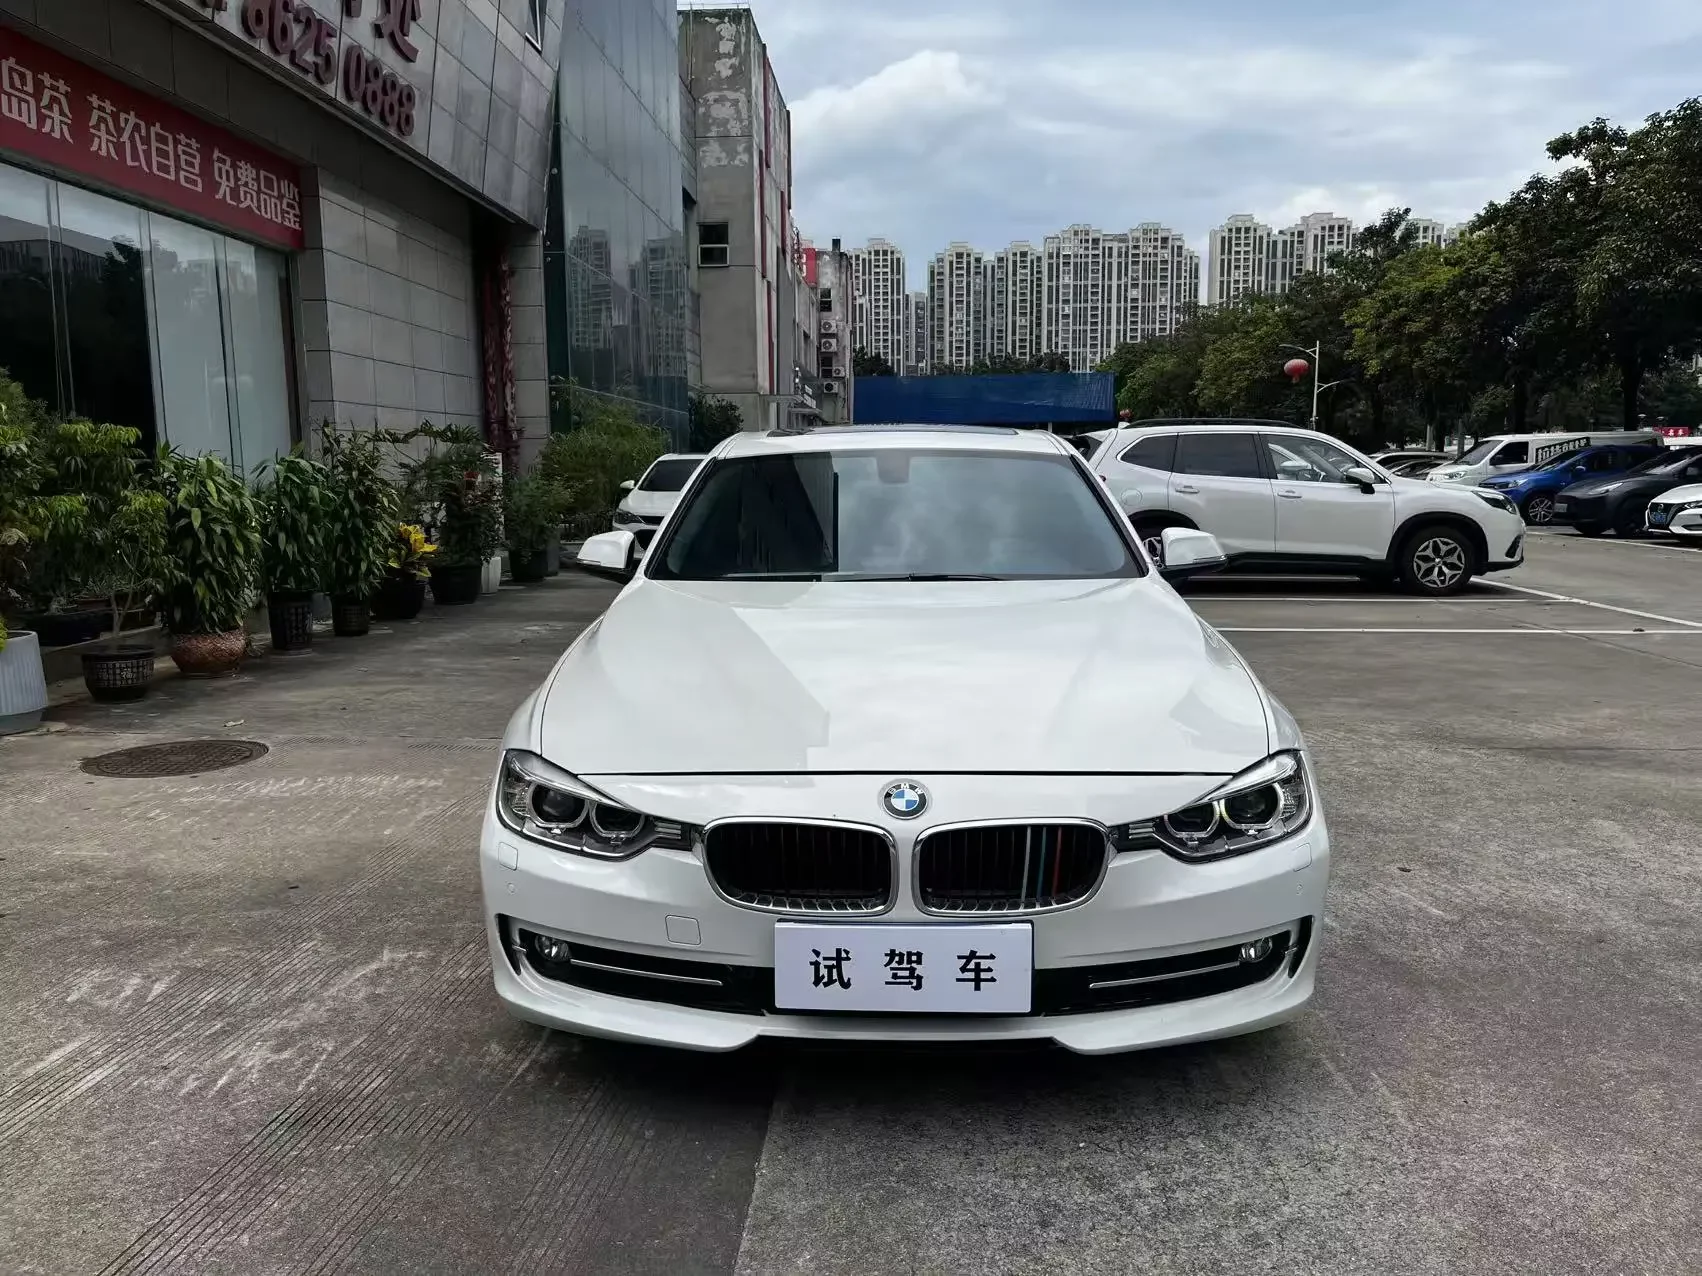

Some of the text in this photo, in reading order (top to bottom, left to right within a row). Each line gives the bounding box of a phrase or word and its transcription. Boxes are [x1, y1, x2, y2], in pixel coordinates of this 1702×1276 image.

[0, 56, 302, 231] 岛茶 茶农自营 免费品鉴
[887, 781, 924, 795] BMW
[809, 948, 997, 991] 试驾车
